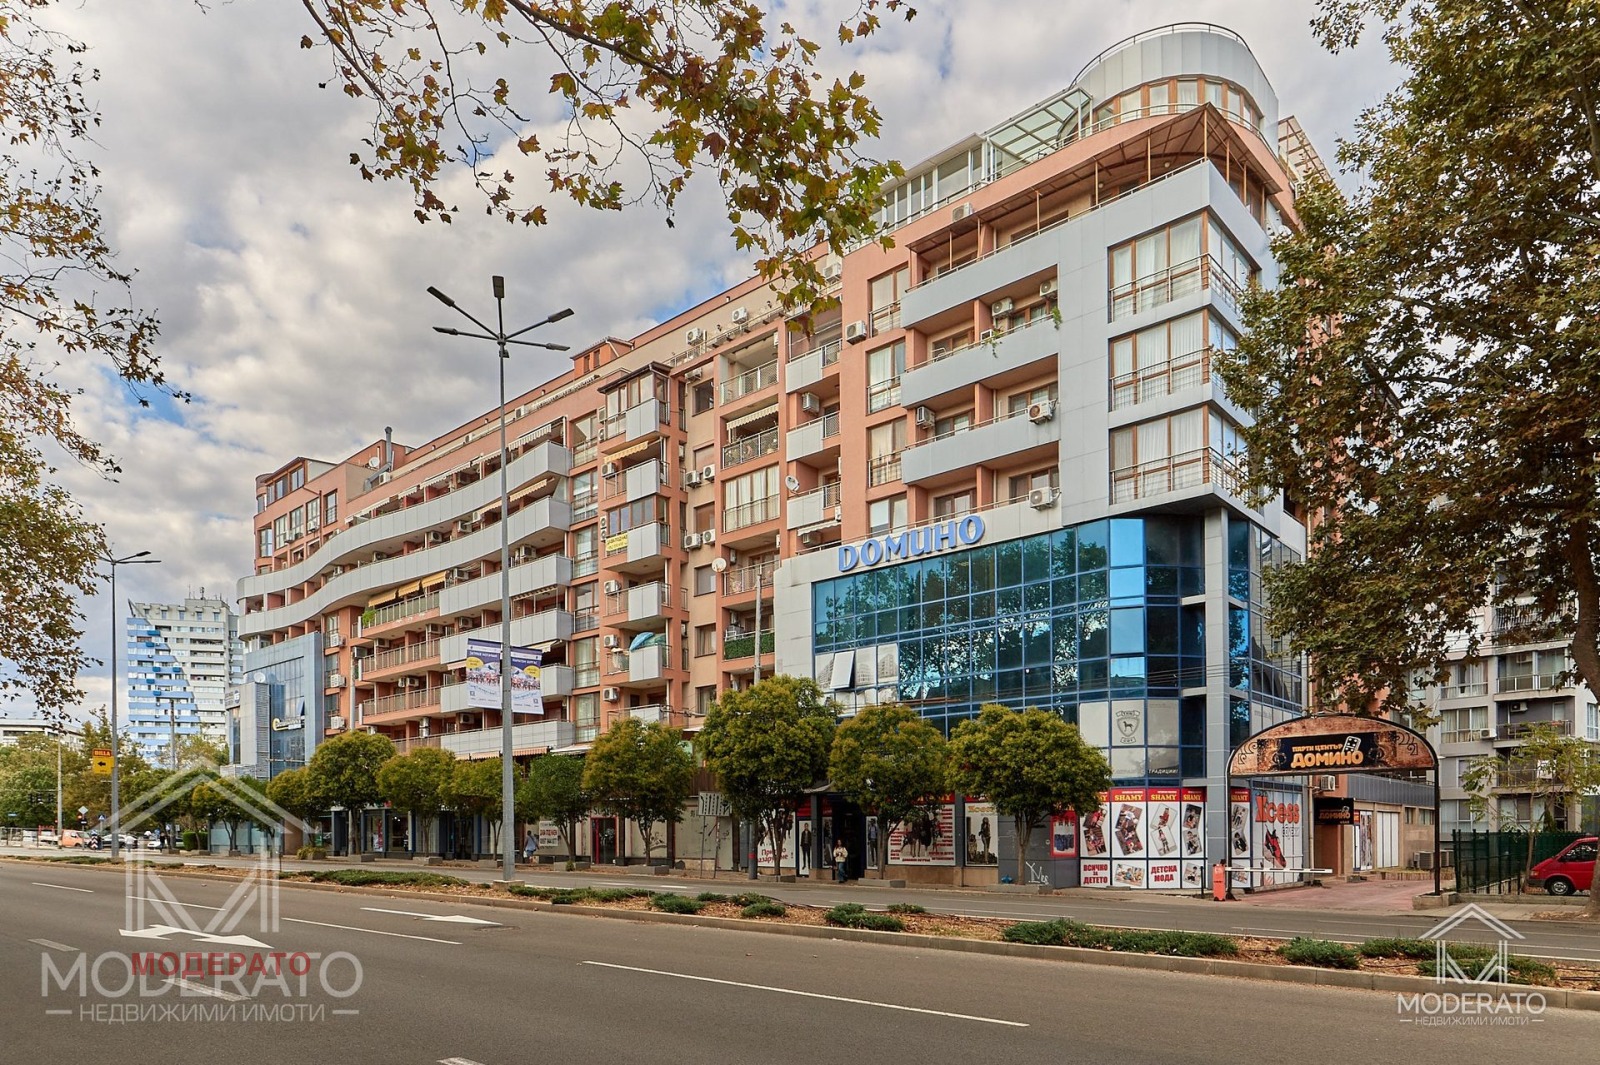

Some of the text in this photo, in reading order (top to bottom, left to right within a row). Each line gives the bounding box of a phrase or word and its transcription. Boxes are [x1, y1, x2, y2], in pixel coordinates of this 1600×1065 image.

[1290, 751, 1364, 769] ДОМИНО
[1083, 863, 1109, 872] ВСИЧКО
[1151, 865, 1177, 875] ДЕТСКА
[1083, 876, 1109, 885] ДЕТЕТО
[1153, 873, 1175, 883] МОДА
